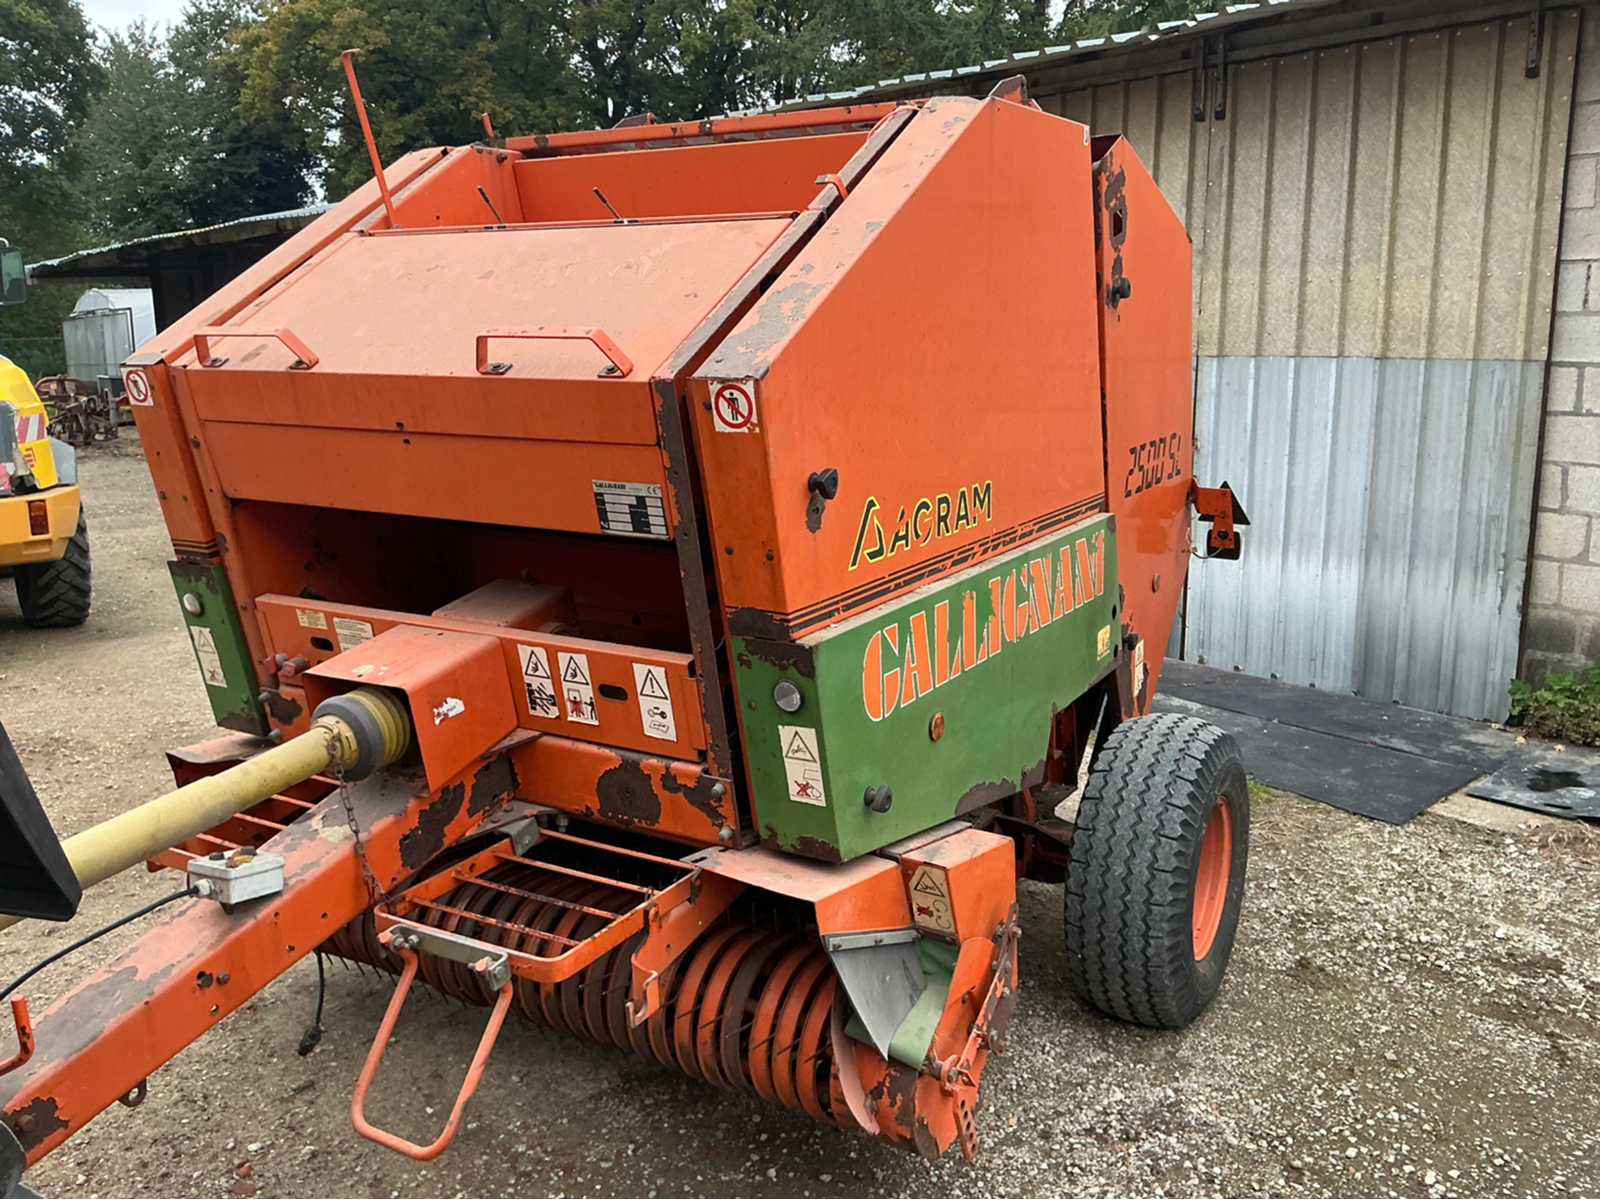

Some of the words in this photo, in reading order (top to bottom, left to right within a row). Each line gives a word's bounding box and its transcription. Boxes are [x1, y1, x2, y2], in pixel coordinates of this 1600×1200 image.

[1124, 436, 1167, 498] 2500
[887, 480, 992, 557] AGRAM
[862, 530, 1105, 722] GALLIGNANI
